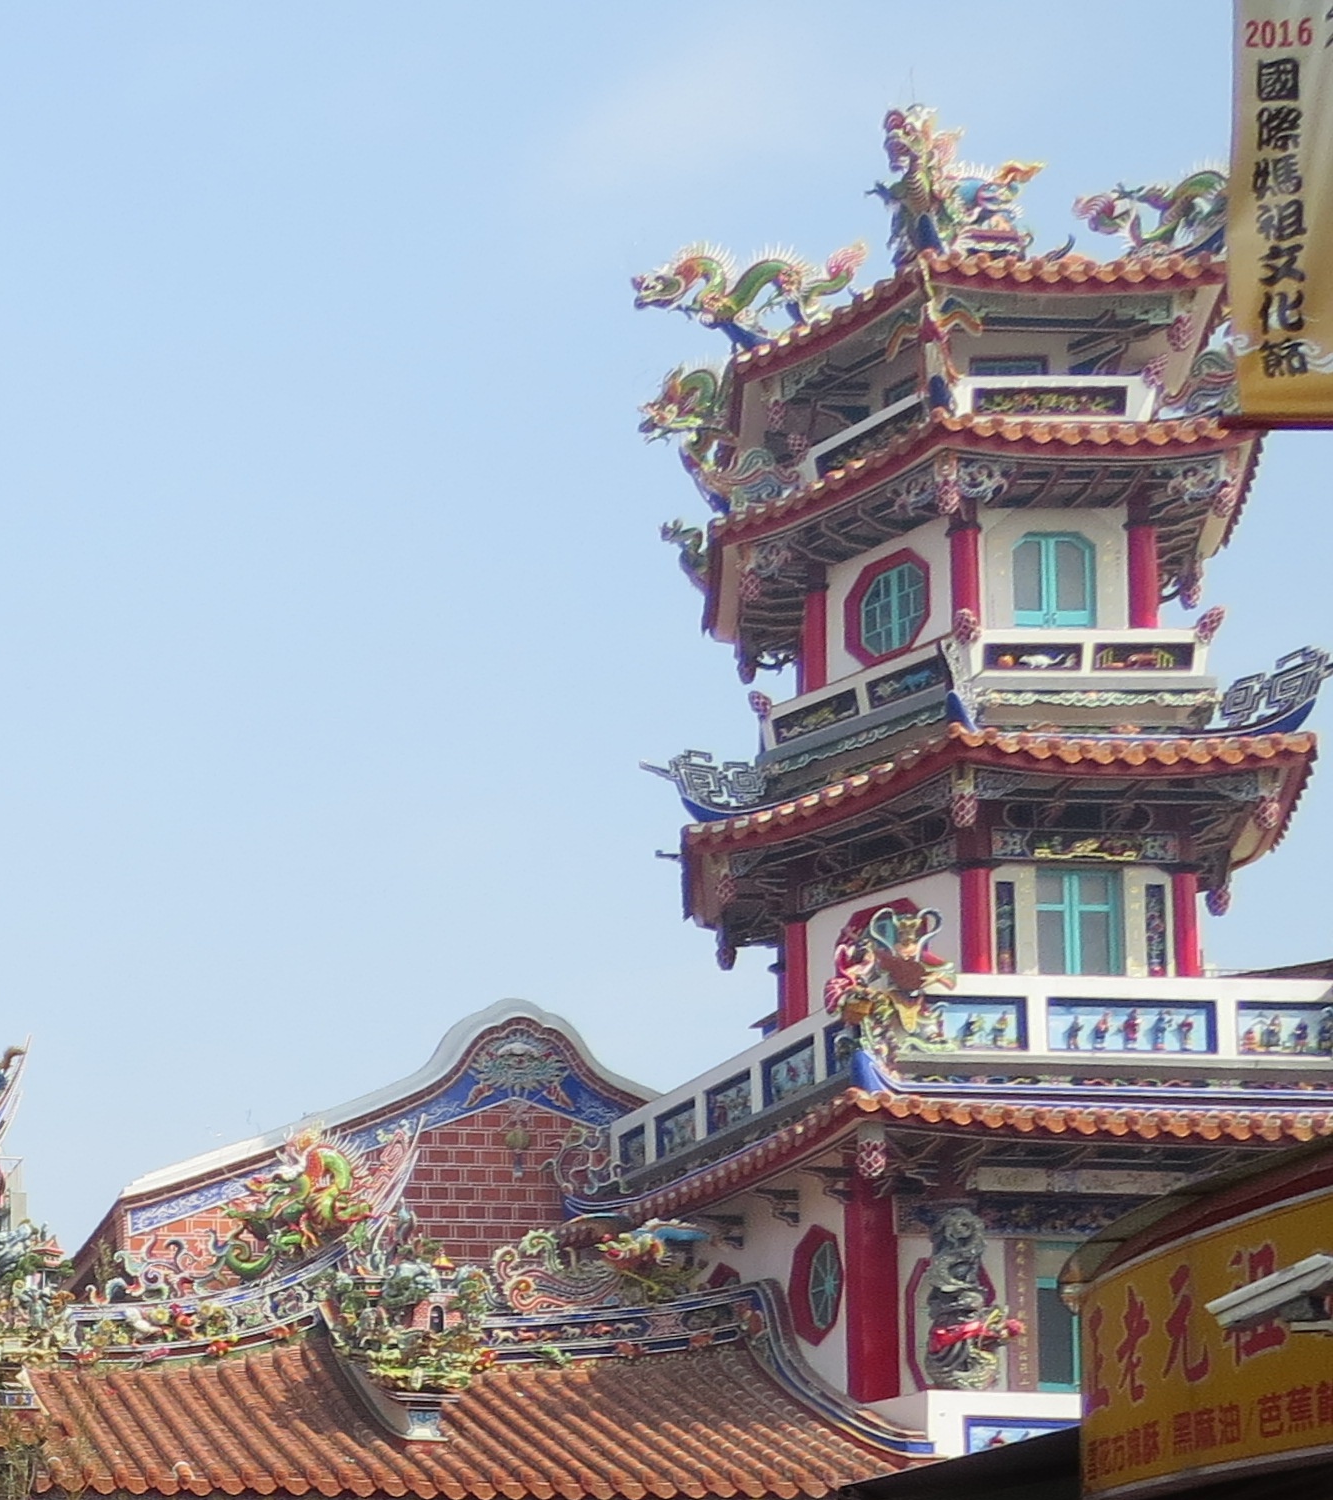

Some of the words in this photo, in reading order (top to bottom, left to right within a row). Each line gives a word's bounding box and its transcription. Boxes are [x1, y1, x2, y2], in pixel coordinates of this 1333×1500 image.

[1245, 17, 1313, 48] 2016
[1252, 57, 1308, 378] 國際媽祖文化節
